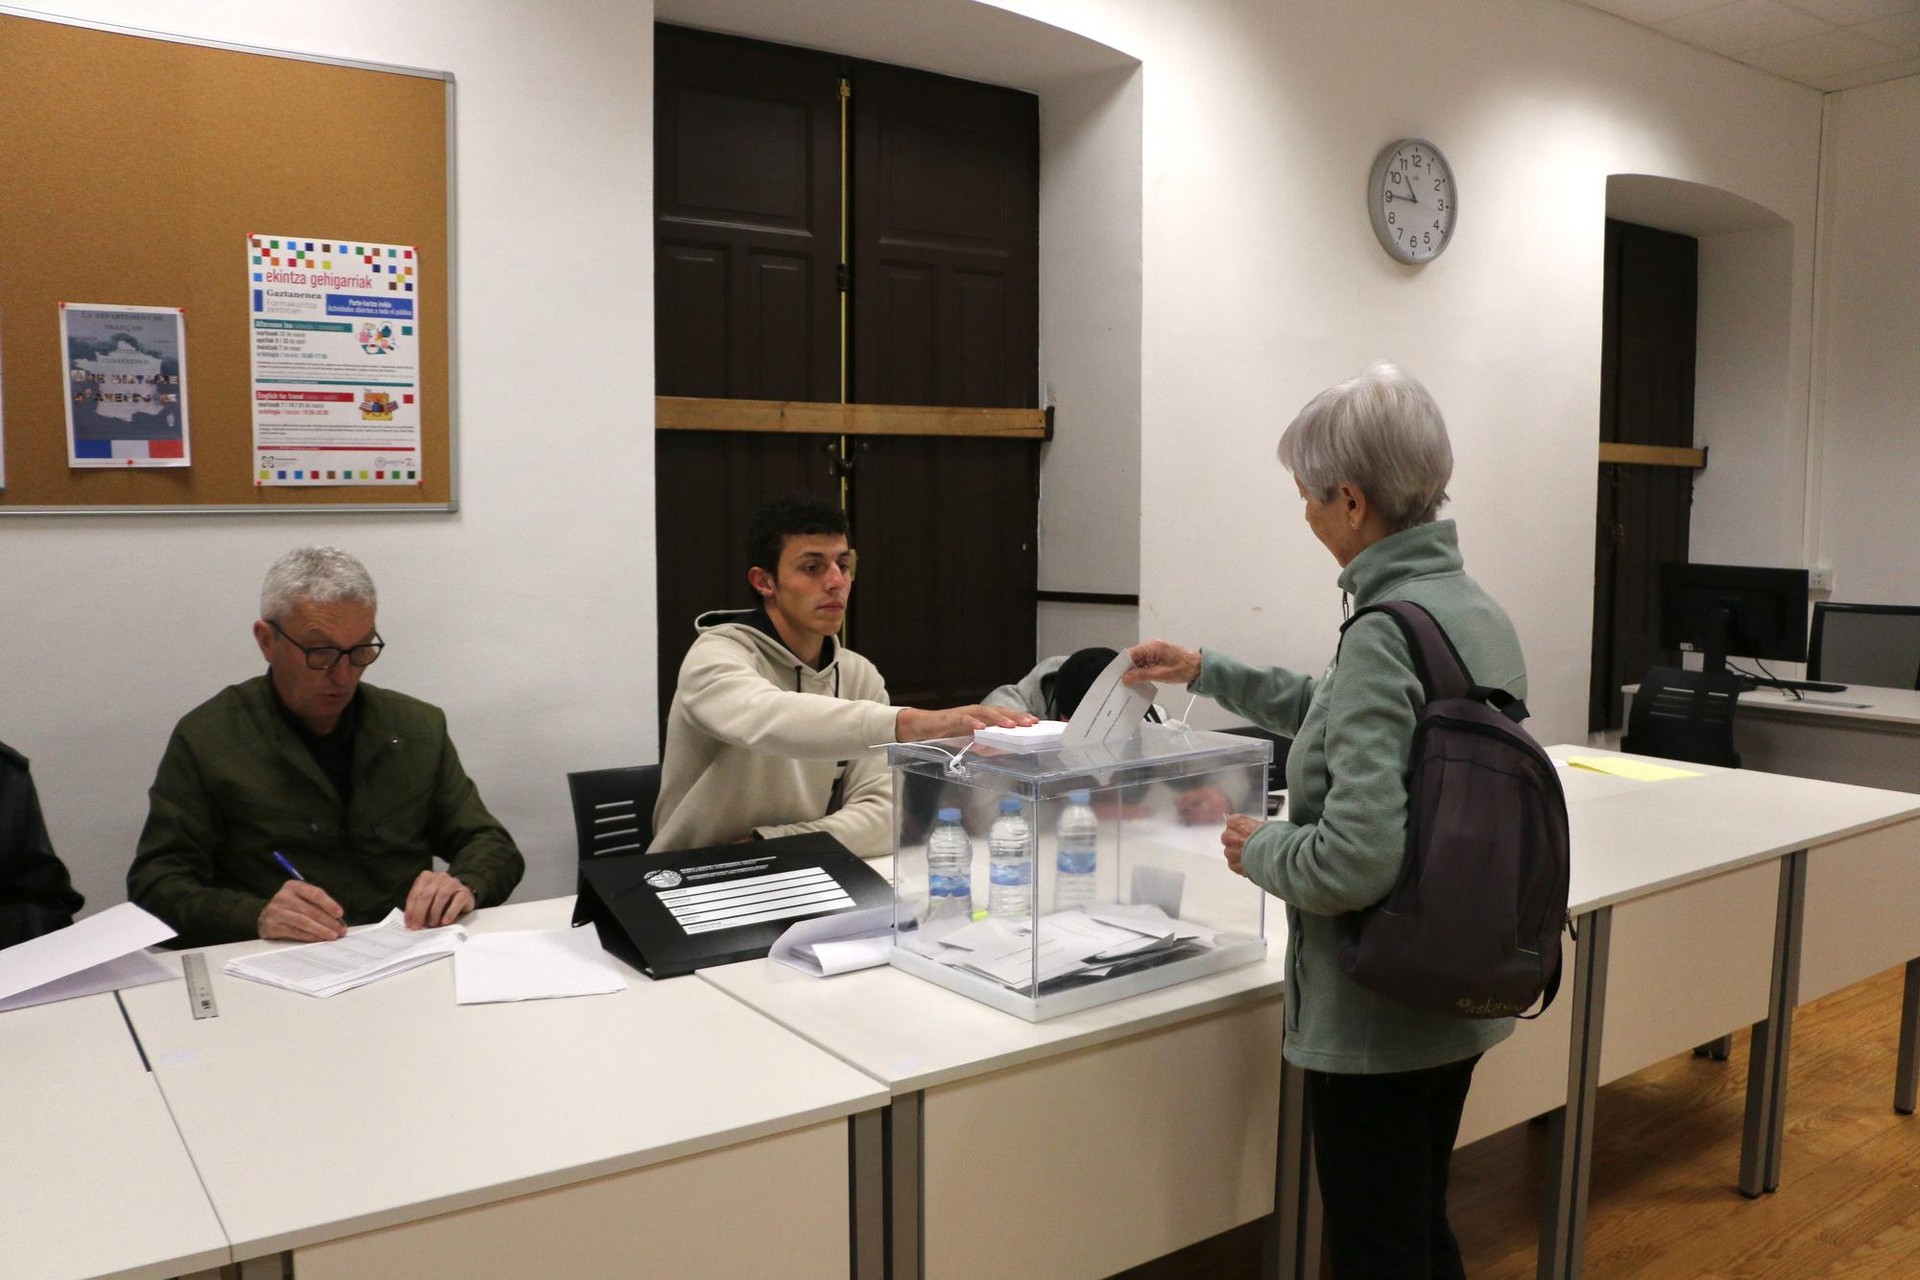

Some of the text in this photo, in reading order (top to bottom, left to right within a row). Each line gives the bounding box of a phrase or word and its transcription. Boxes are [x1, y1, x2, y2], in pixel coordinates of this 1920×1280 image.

[1400, 158, 1408, 170] 11
[1411, 154, 1421, 167] 12
[1427, 163, 1431, 175] 1
[1390, 171, 1402, 184] 10
[1434, 179, 1441, 191] 2
[1385, 190, 1393, 203] 9
[1437, 199, 1444, 211] 3
[1388, 212, 1395, 224] 8
[1433, 219, 1439, 231] 4
[1397, 228, 1403, 240] 7
[1424, 231, 1430, 244] 5
[1410, 235, 1418, 248] 6
[266, 269, 373, 290] ekintza gehigarriak
[266, 289, 322, 300] Gaztanenea
